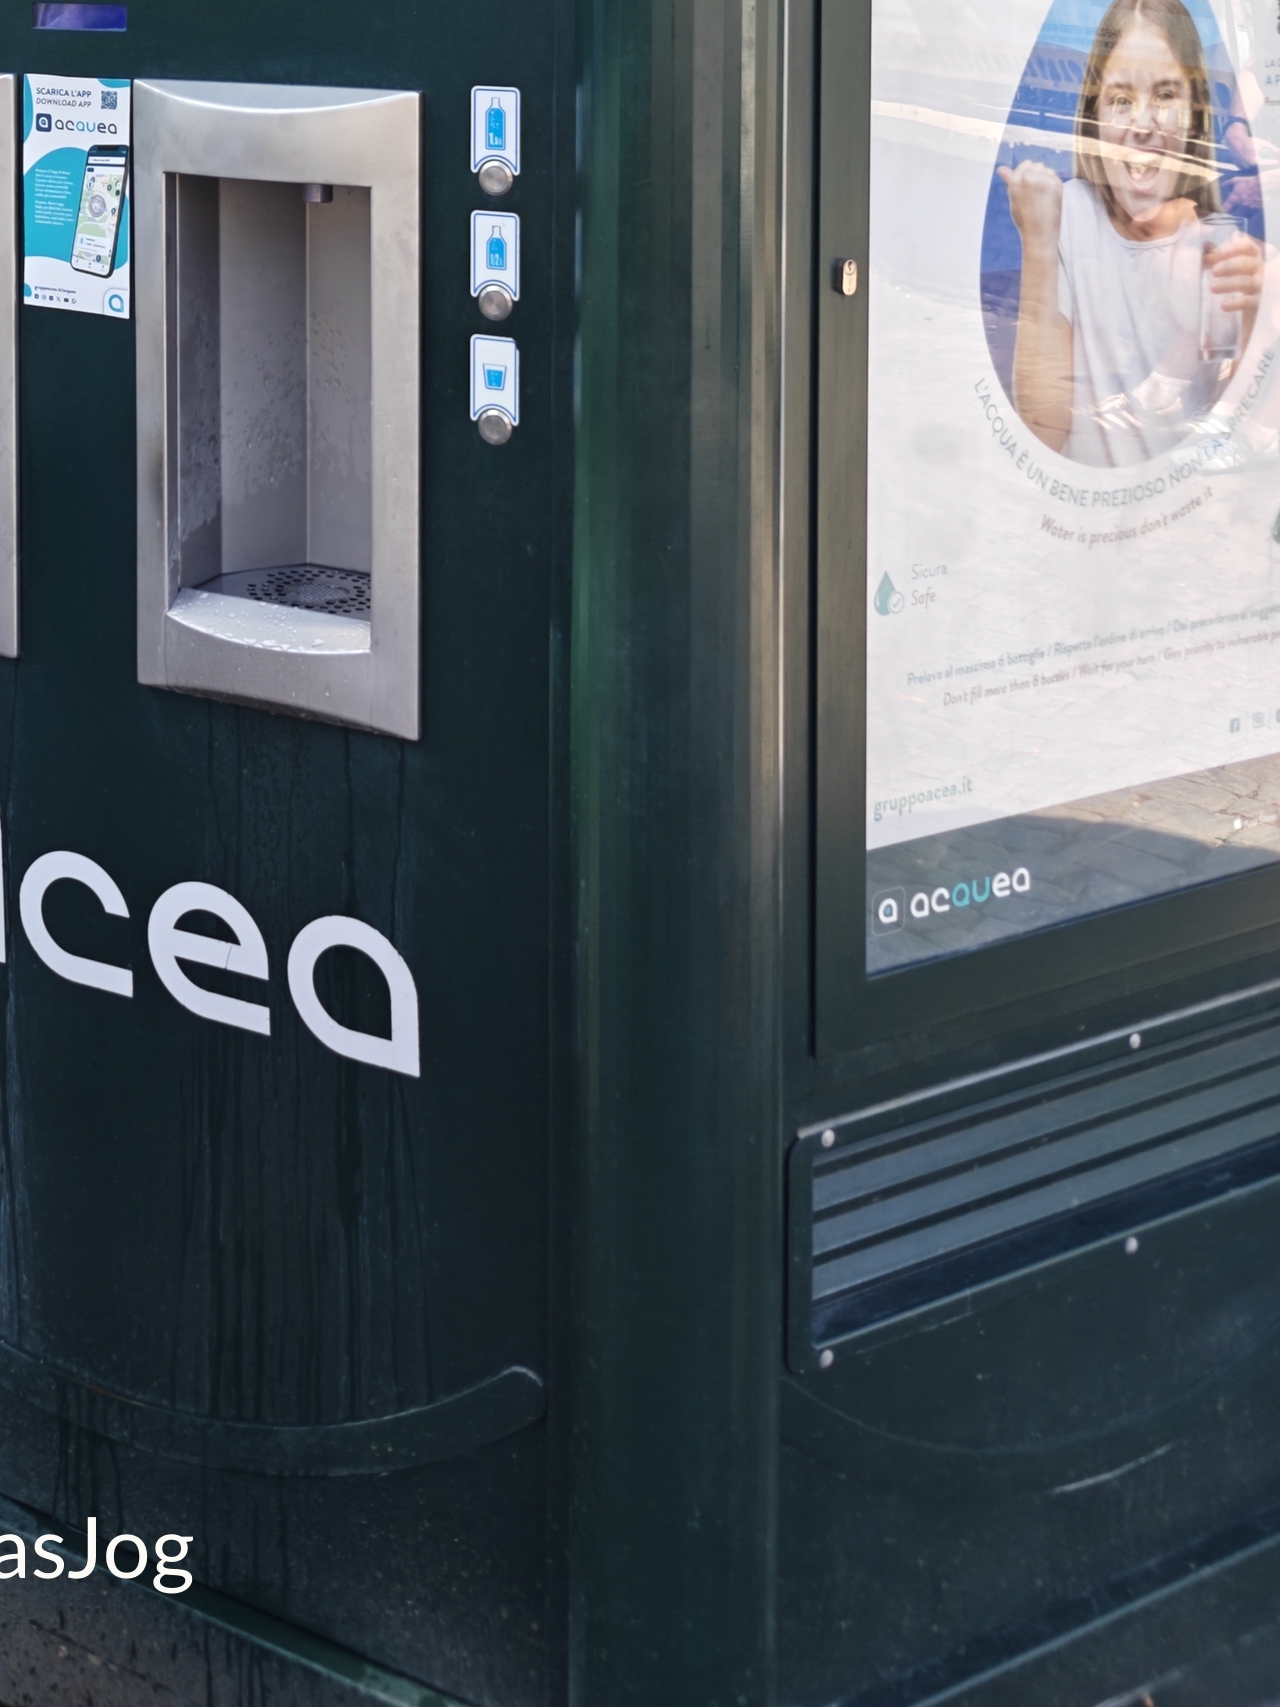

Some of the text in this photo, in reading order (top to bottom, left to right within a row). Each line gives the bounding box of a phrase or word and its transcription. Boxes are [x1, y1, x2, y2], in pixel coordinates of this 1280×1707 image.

[36, 87, 69, 96] SCARICA
[36, 98, 76, 107] DOWNLOAD
[974, 378, 1018, 458] L'ACQUA
[1027, 462, 1049, 490] UN
[1050, 479, 1087, 507] BENE
[1092, 478, 1165, 507] PREZIOSO
[1169, 454, 1203, 488] NON
[1040, 486, 1213, 549] Water is precious don't waste it
[911, 564, 947, 580] Sicura
[911, 587, 936, 609] Safe
[943, 689, 968, 706] Don't
[873, 775, 973, 821] gruppoacea.it
